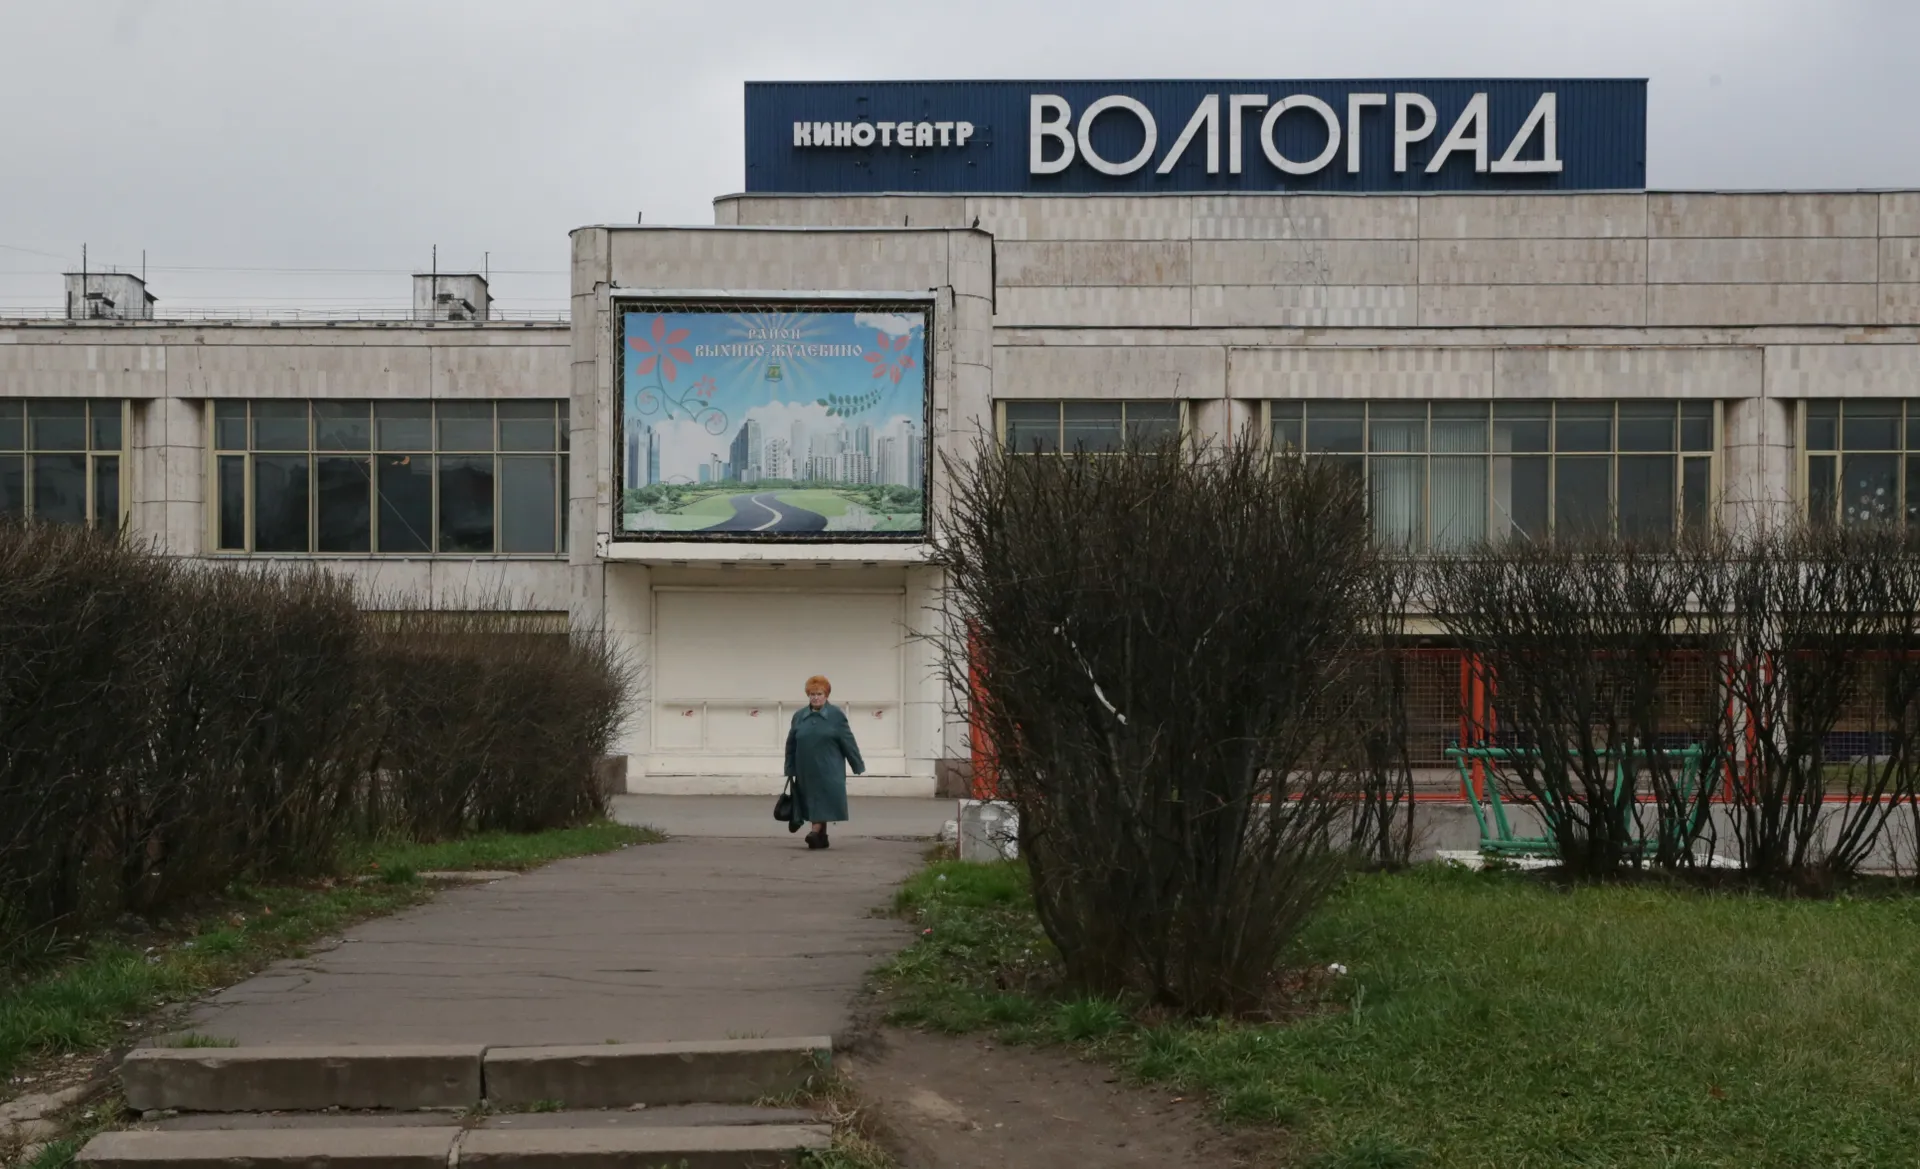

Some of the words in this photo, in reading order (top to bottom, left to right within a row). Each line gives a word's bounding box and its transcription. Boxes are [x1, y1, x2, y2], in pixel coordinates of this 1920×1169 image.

[793, 121, 974, 147] КИНОТЕАТР
[1029, 92, 1563, 176] ВОЛГОГРАД
[694, 344, 864, 358] ВЫХИНО-ЖУЛЕБИНО
